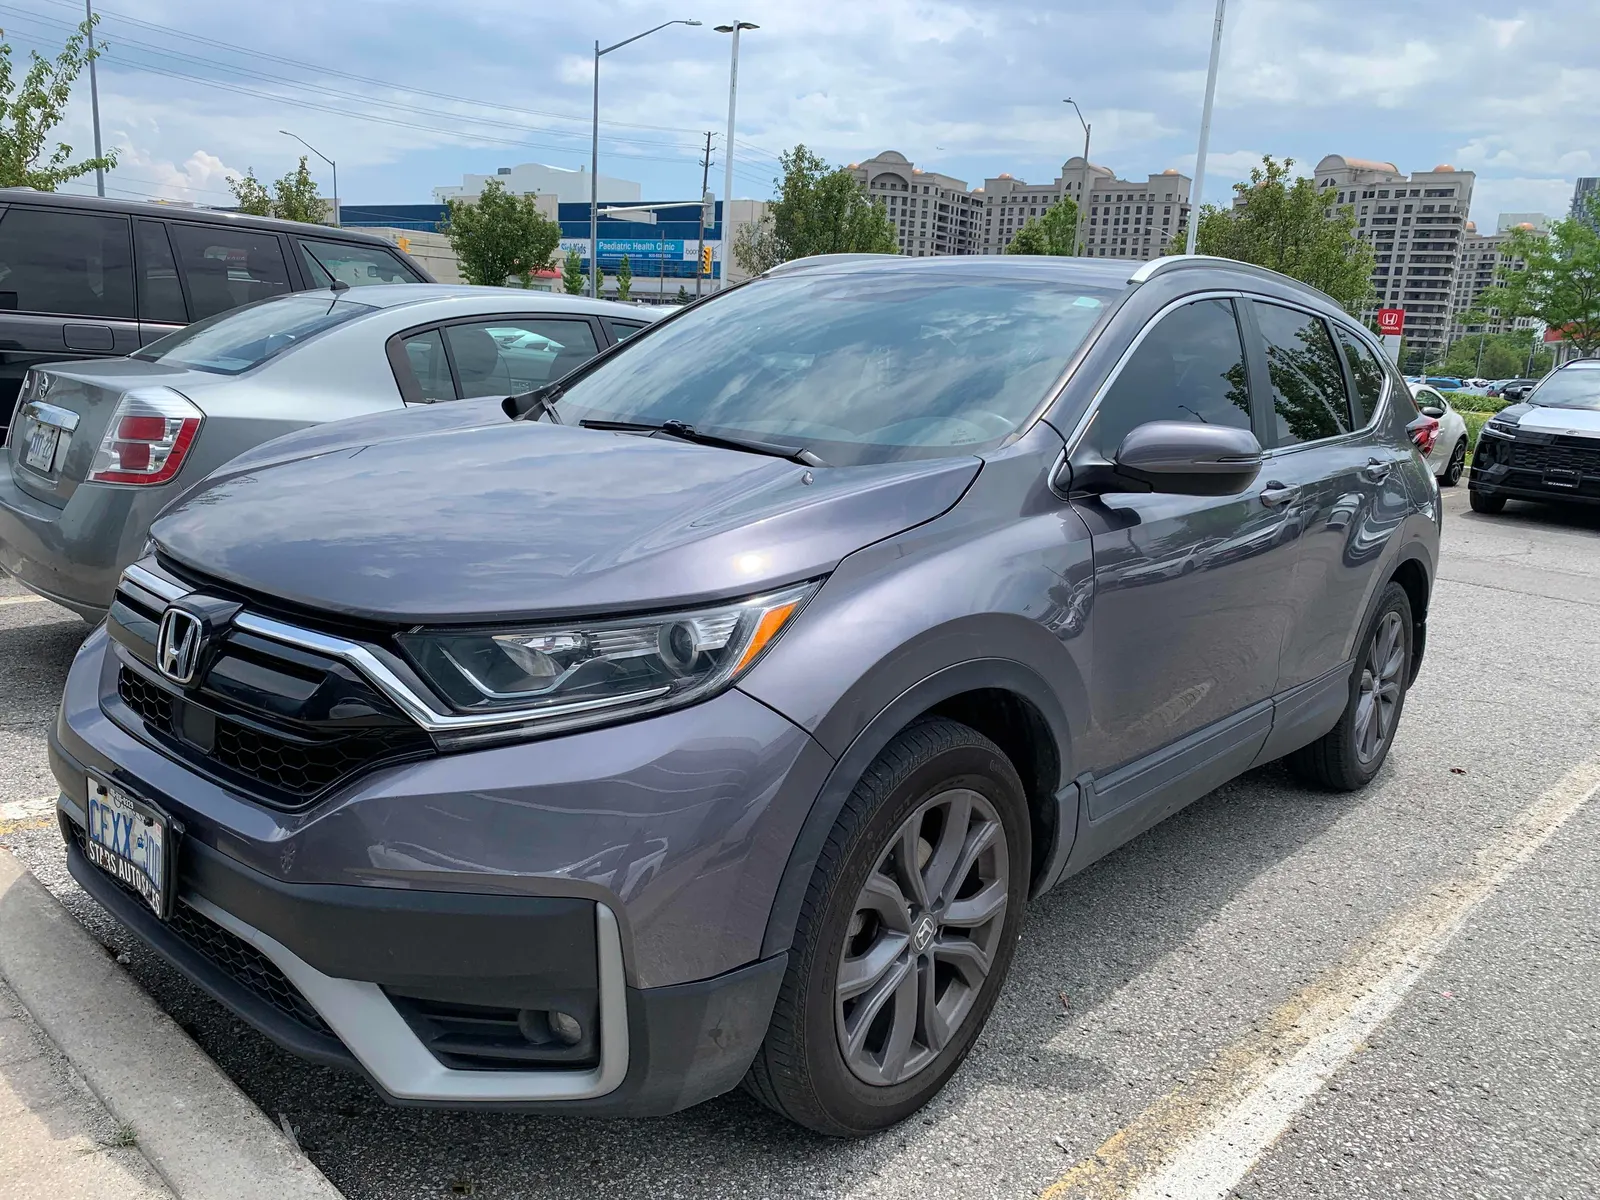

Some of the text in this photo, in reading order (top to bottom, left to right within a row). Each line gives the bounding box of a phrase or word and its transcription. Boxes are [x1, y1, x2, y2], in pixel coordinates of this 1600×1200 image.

[598, 241, 676, 251] Paediatric Health Clnic
[89, 798, 133, 861] CFXX
